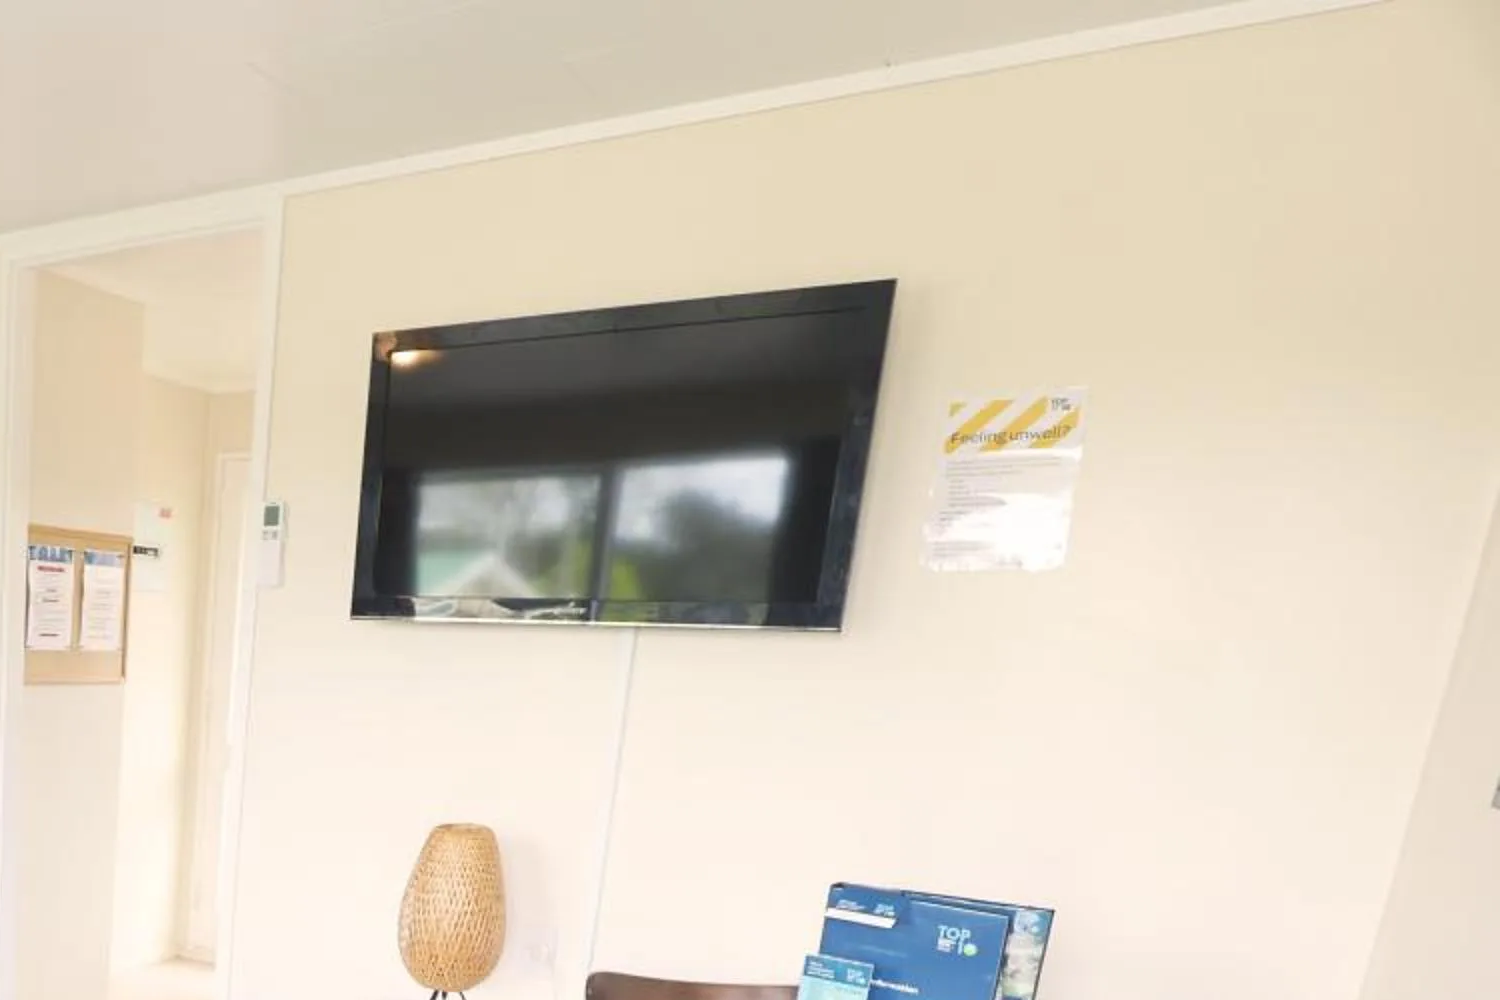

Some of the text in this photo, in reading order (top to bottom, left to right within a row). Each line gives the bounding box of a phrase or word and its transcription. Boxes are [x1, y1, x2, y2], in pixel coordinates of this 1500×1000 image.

[951, 424, 1072, 444] Feeling unwell?
[937, 925, 972, 942] TOP
